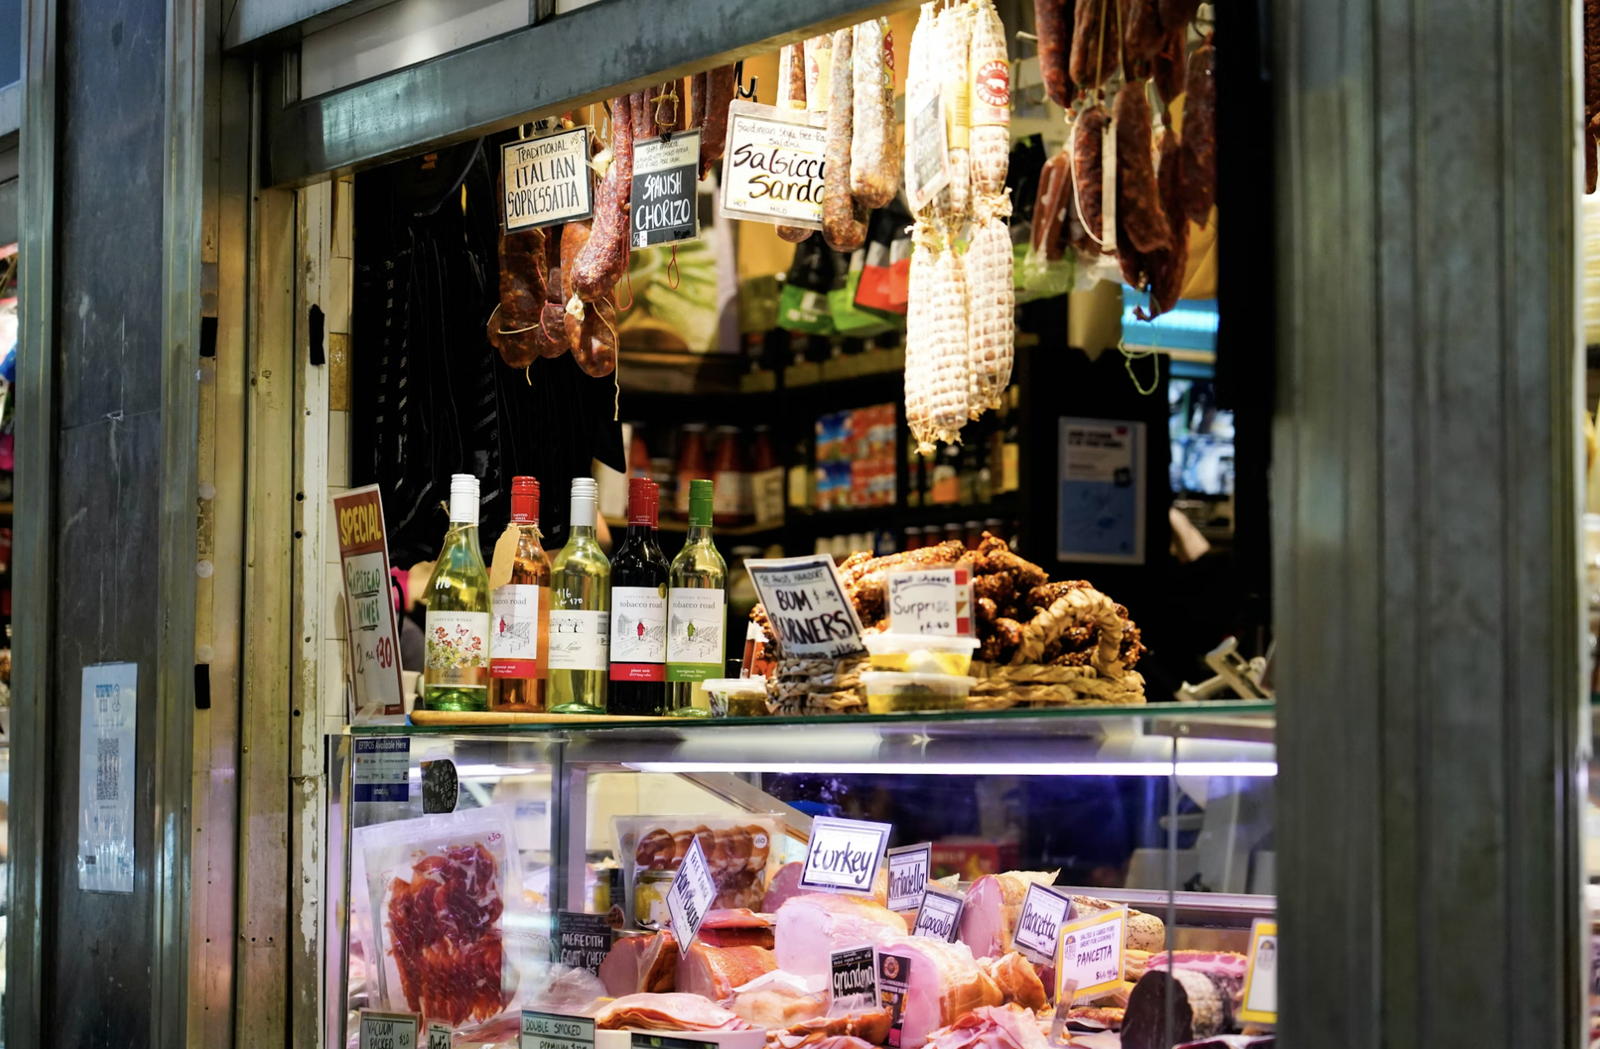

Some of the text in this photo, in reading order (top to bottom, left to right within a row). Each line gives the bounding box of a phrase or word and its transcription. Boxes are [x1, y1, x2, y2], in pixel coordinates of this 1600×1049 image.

[737, 120, 775, 136] Sardinian
[516, 139, 568, 164] TRADITIONAL
[516, 154, 576, 188] ITALIAN
[507, 180, 580, 218] SOPRESSATTA
[642, 170, 682, 202] SPANISH
[635, 198, 690, 230] CHORIZO
[769, 206, 788, 214] MILD
[341, 502, 382, 546] SPECIAL
[356, 598, 380, 624] WINES
[620, 600, 662, 609] tobacco road
[776, 589, 813, 612] BUM
[770, 610, 853, 644] BURNERS
[356, 643, 364, 675] 2
[358, 740, 406, 750] EFTPOS Available Here
[812, 840, 873, 884] turkey
[888, 863, 925, 900] Mortadella
[918, 908, 951, 938] Capocollo
[1022, 902, 1056, 941] Pancetta
[562, 933, 604, 948] MEREDITH
[1076, 944, 1112, 968] PANCETTA
[367, 1022, 394, 1036] VACUUM
[526, 1018, 582, 1036] DOUBLE SMOKED
[370, 1038, 394, 1049] PACKED
